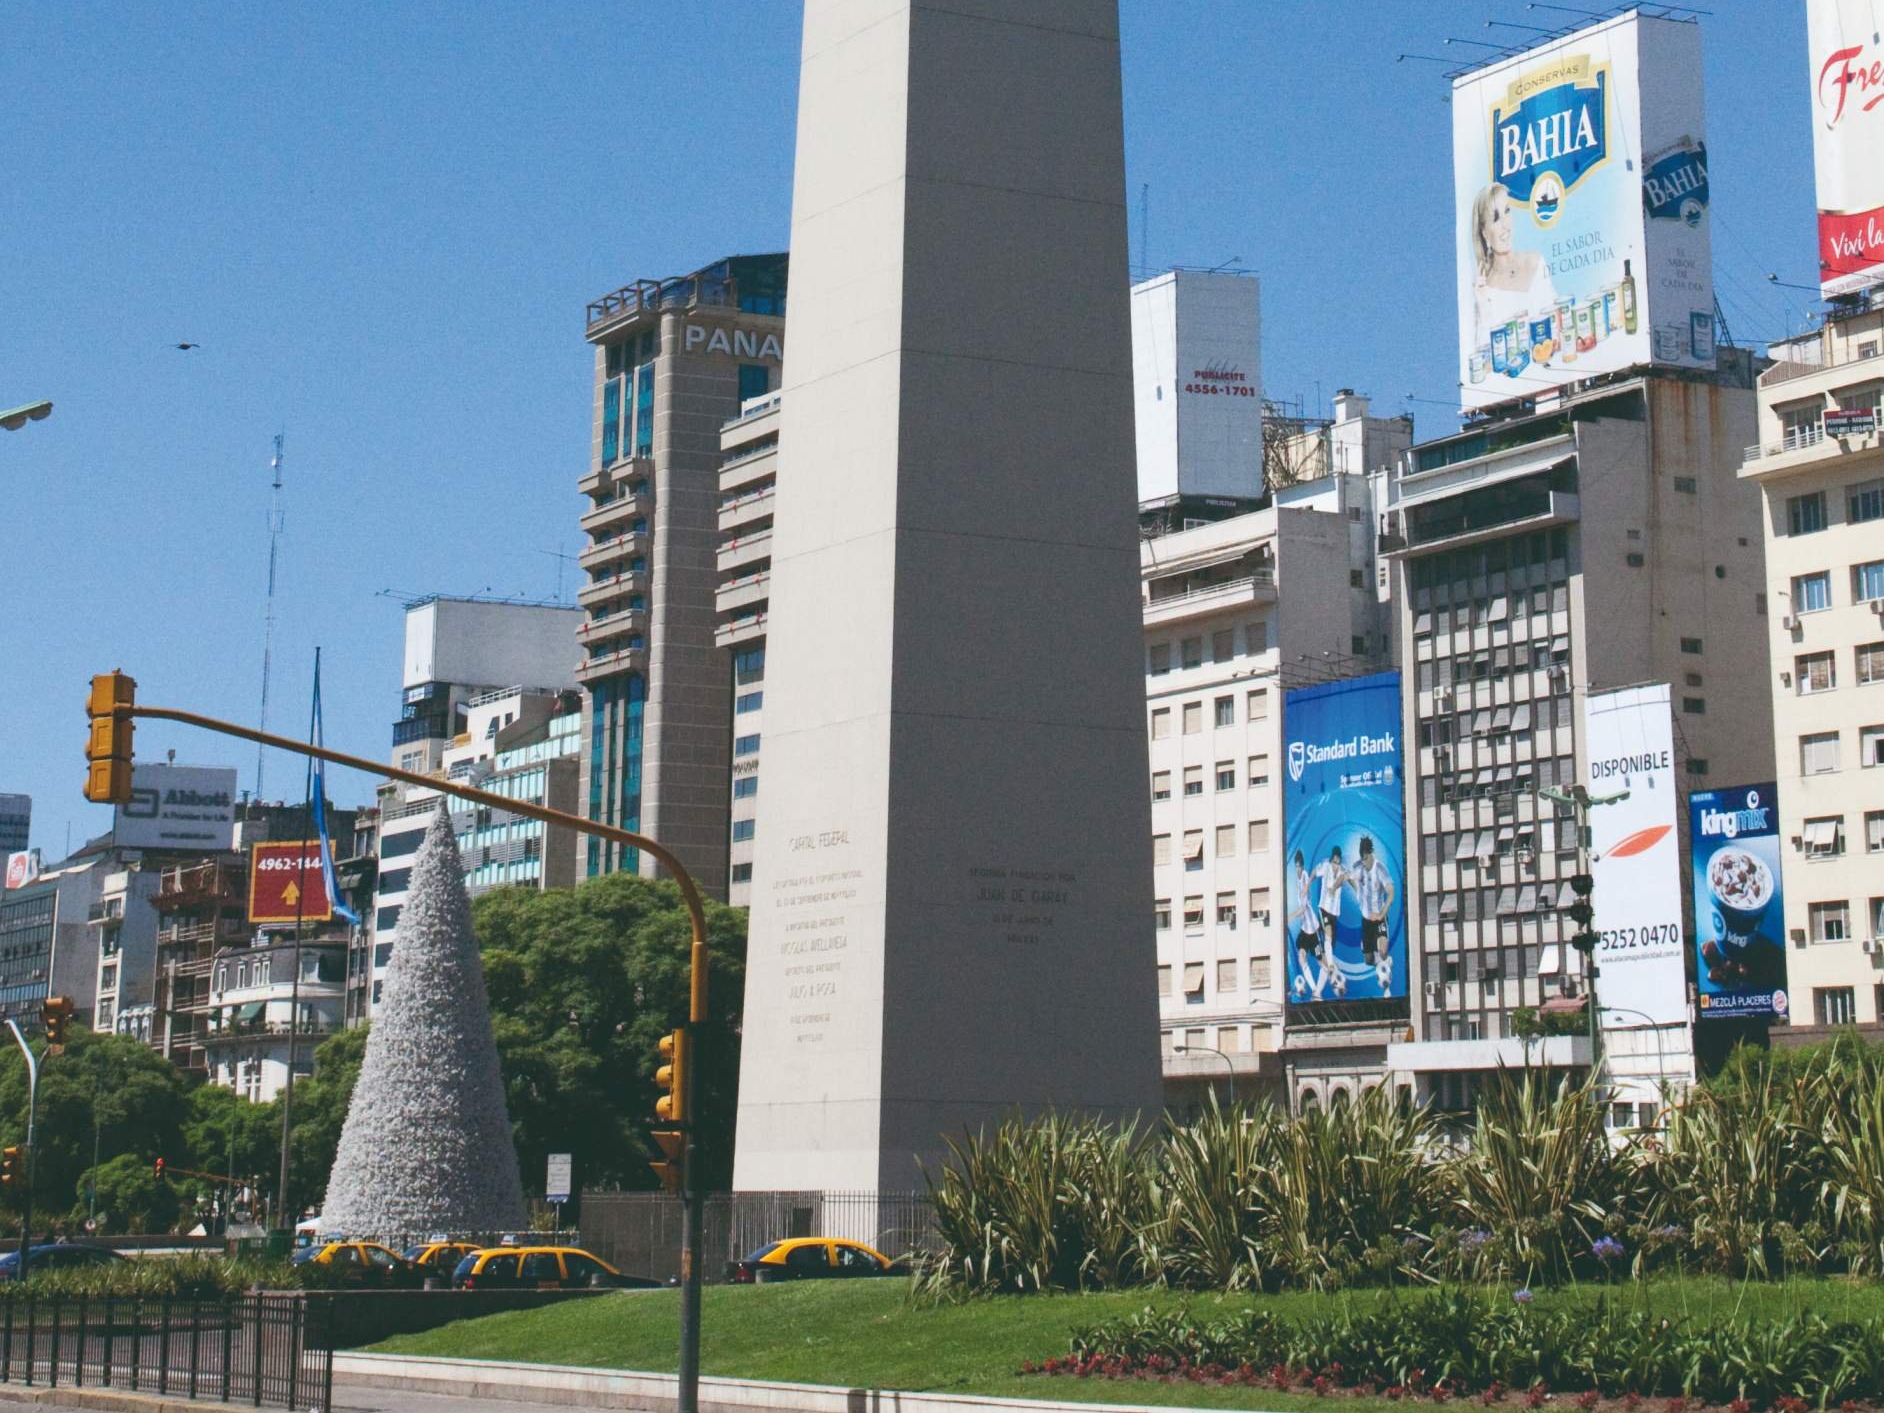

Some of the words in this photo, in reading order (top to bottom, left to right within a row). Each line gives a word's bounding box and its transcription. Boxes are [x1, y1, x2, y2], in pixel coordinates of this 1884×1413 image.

[1515, 65, 1580, 95] CONSERVAS
[1819, 45, 1884, 126] Fre
[1500, 103, 1598, 177] BAHIA
[1645, 159, 1708, 207] BAHIA
[1552, 243, 1564, 258] EL
[1566, 231, 1602, 252] SABOR
[1544, 263, 1557, 278] DE
[1559, 253, 1590, 272] CADA
[1185, 383, 1255, 397] 4556-1701
[1306, 737, 1357, 764] Standard
[1360, 732, 1395, 755] Bank
[1592, 751, 1669, 779] DISPONIBLE
[163, 789, 230, 807] Abbott
[258, 857, 323, 870] 4962-144
[1602, 928, 1637, 951] 5252
[1641, 924, 1679, 947] 0470
[1727, 931, 1748, 948] king
[1738, 995, 1772, 1006] PLACERES
